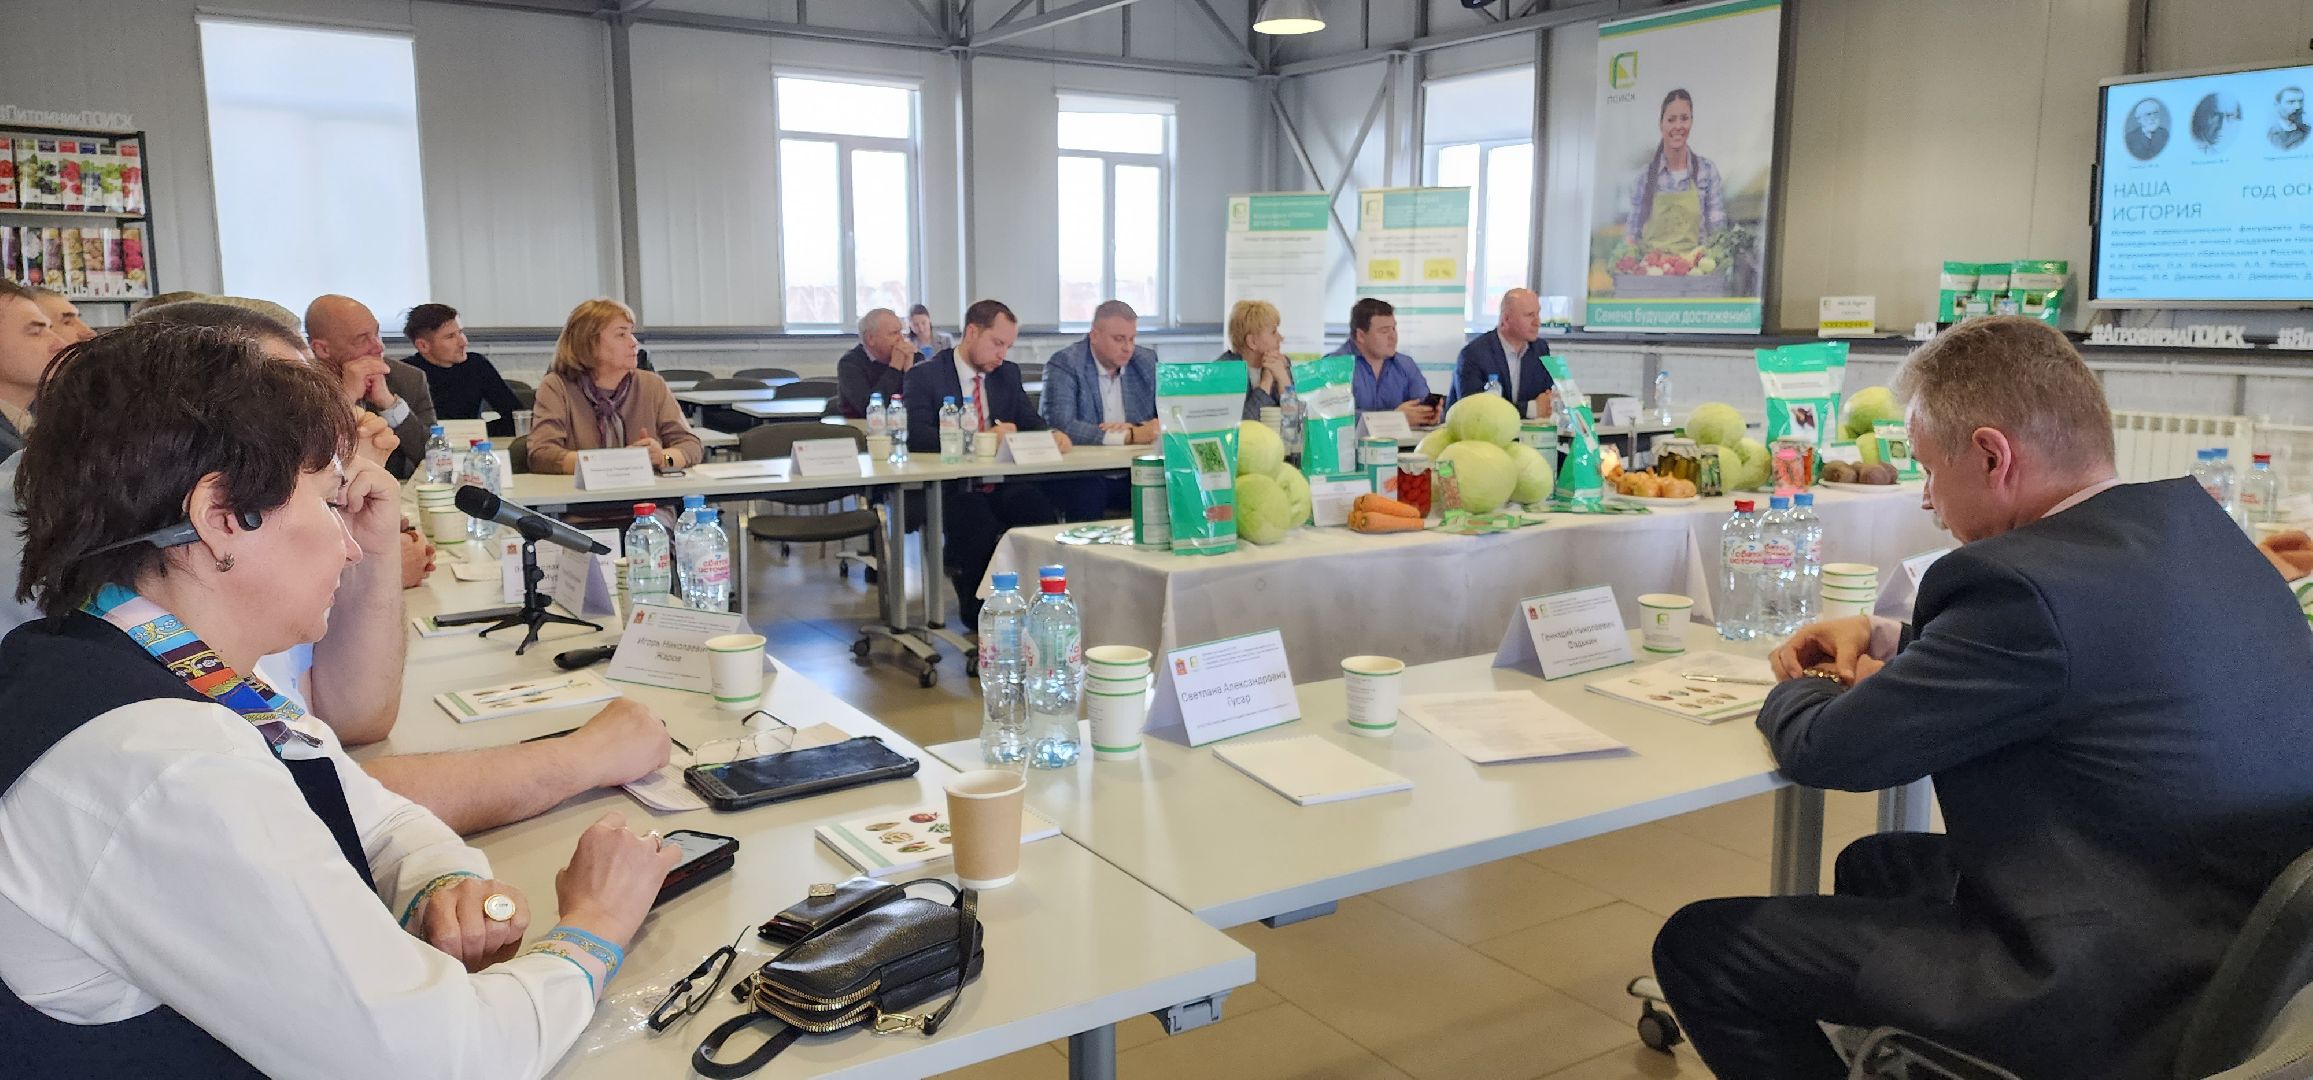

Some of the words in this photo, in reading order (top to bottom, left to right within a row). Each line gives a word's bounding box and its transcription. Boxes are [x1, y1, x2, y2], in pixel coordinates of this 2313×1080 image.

[2113, 181, 2172, 198] НАША
[2242, 185, 2277, 199] ГОД
[2112, 203, 2202, 221] ИСТОРИЯ
[1594, 307, 1633, 323] Семена
[637, 636, 660, 648] Игорь
[1181, 685, 1222, 702] Светлана
[1223, 670, 1287, 691] Александровна
